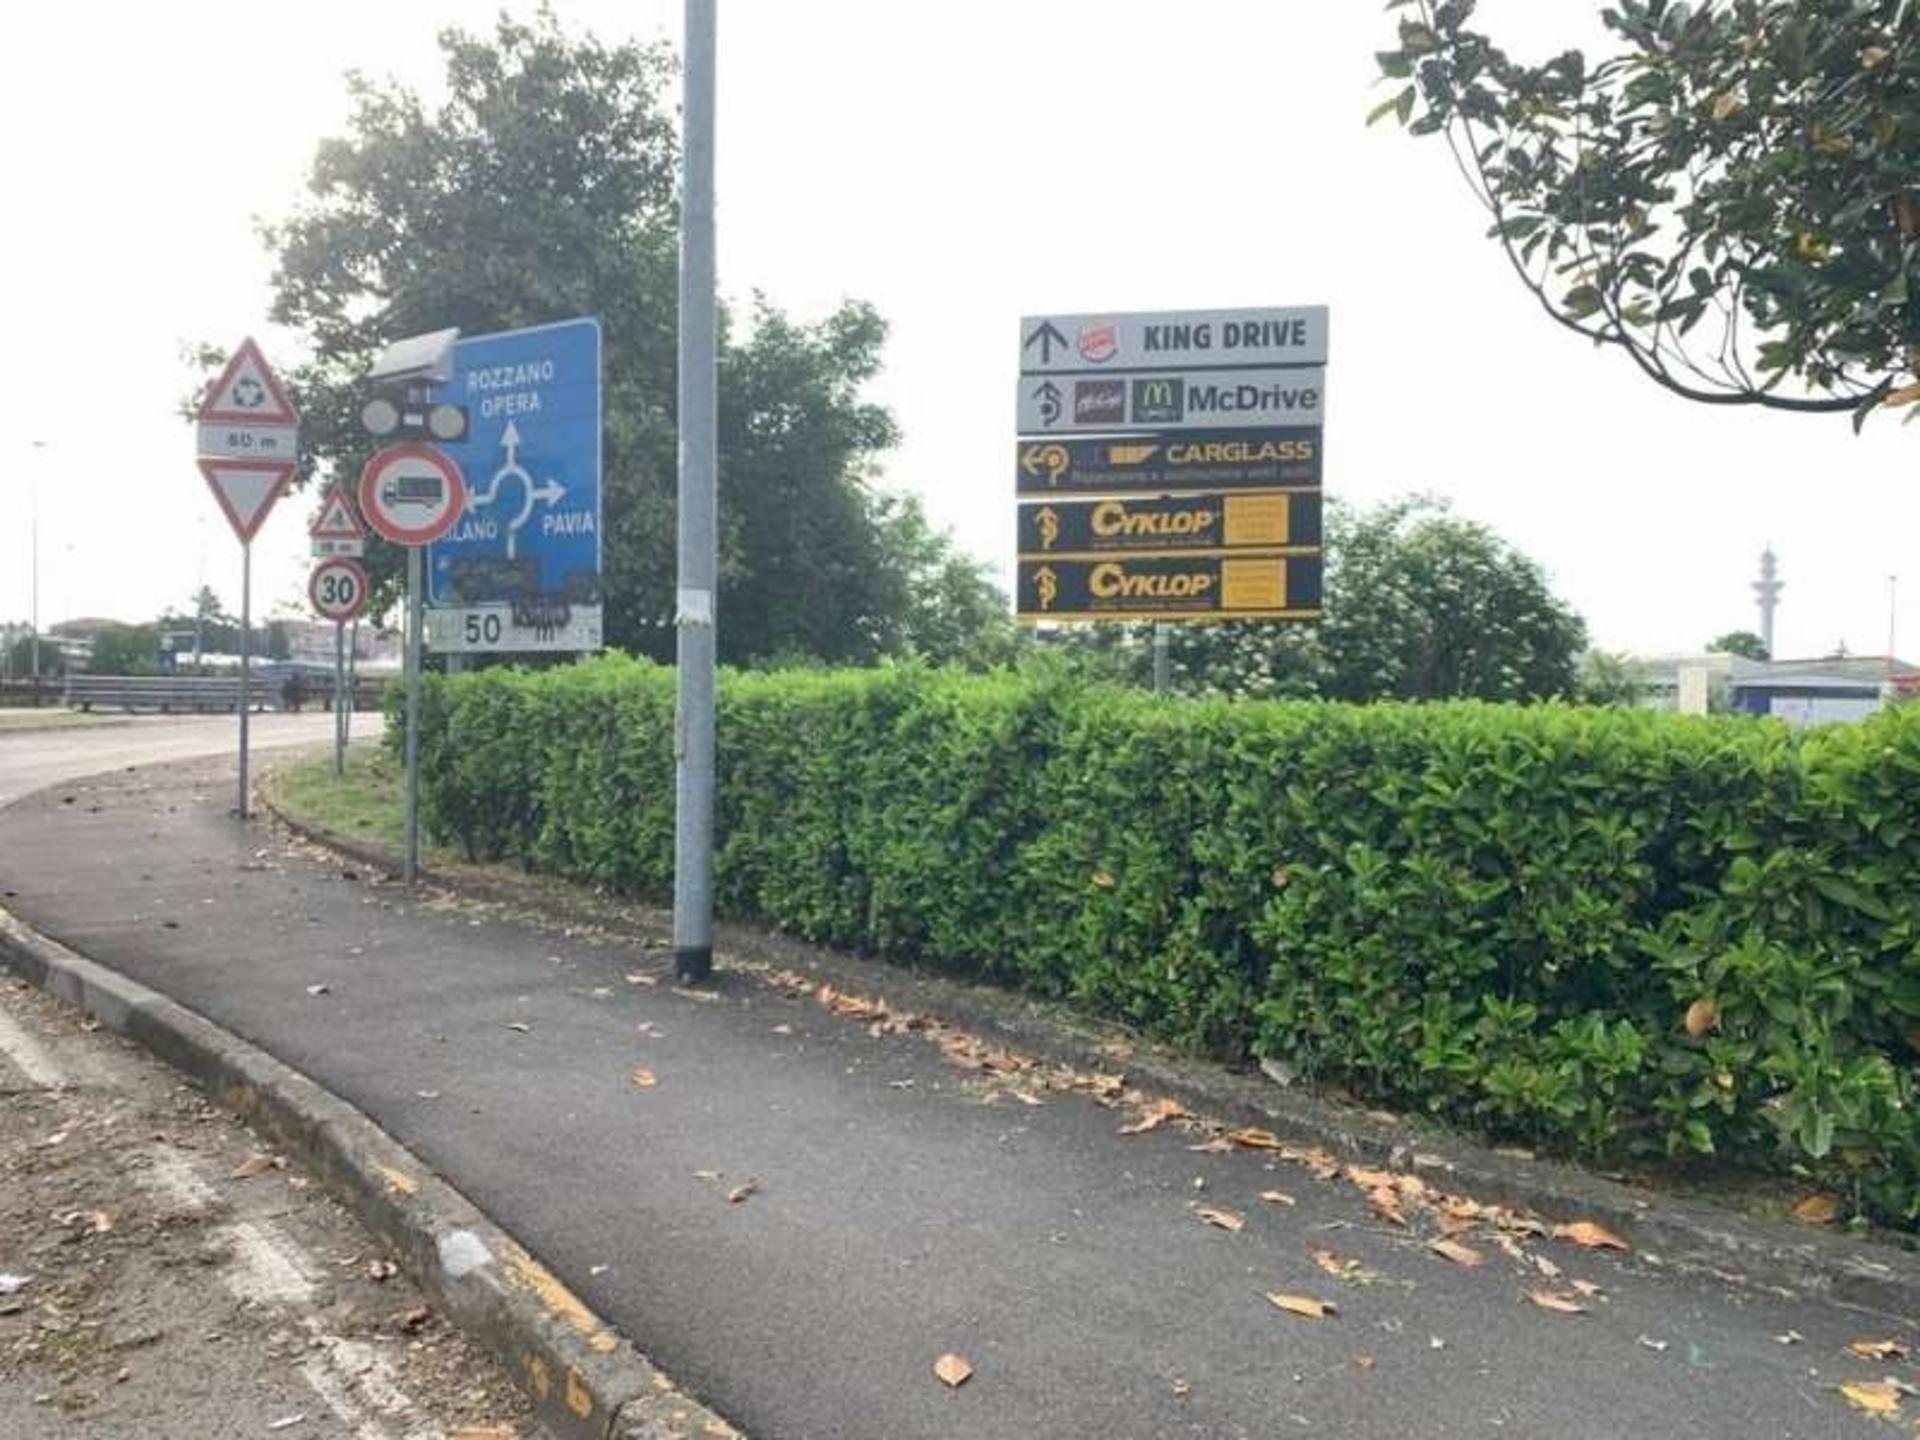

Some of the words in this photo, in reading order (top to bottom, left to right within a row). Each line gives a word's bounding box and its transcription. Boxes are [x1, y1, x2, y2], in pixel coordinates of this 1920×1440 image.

[1144, 323, 1212, 351] KING
[1223, 320, 1307, 348] DRIVE
[466, 359, 553, 395] ROZZANO
[481, 391, 540, 418] OPERA
[1189, 385, 1318, 411] McDrive
[1166, 440, 1313, 463] CARGLASS
[543, 511, 596, 537] PAVIA
[321, 575, 355, 606] 30
[465, 613, 501, 644] 50
